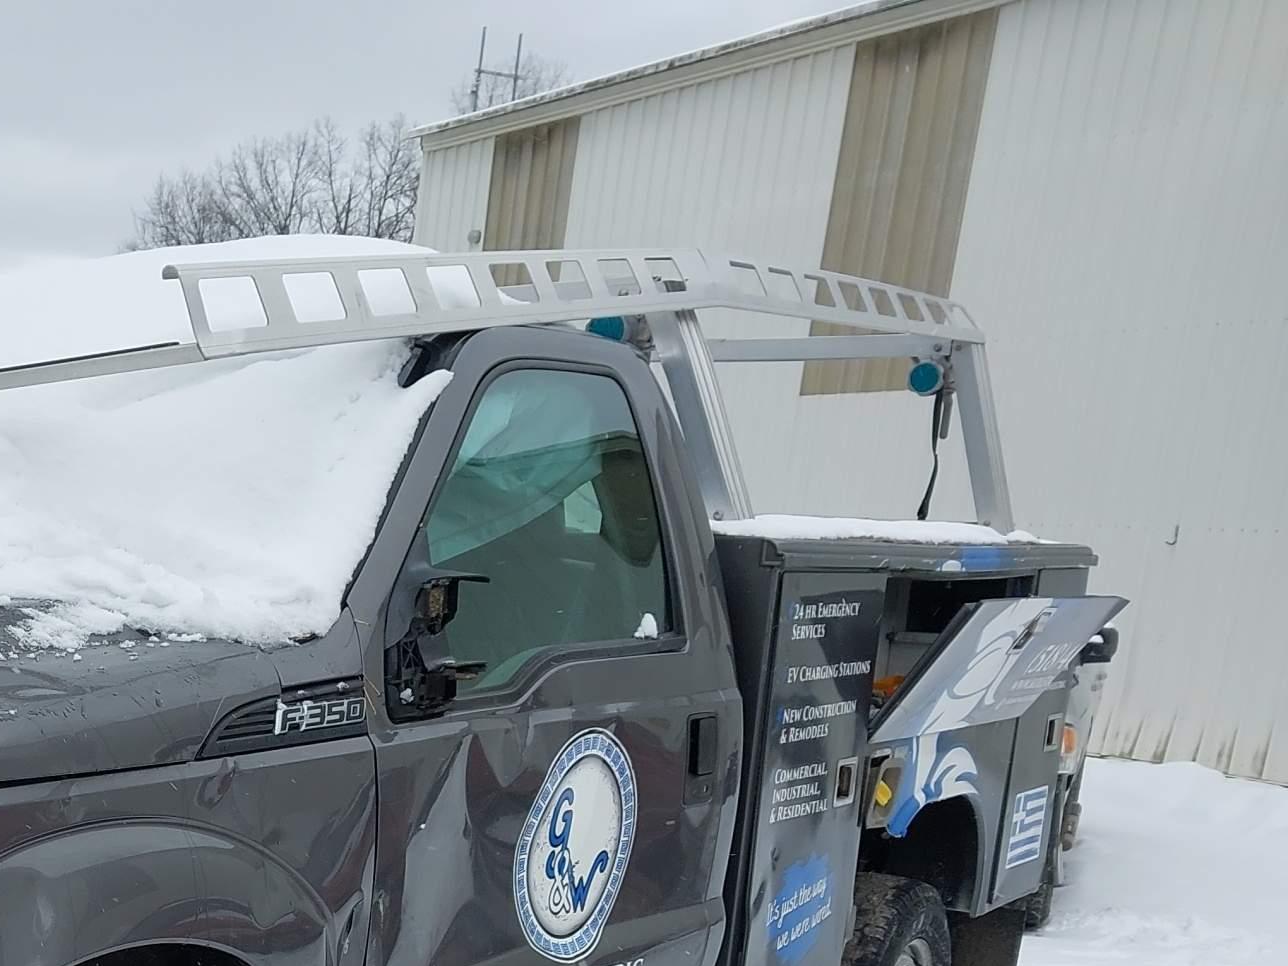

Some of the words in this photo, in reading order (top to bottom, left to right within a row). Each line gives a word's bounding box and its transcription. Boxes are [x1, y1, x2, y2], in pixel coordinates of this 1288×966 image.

[793, 603, 804, 620] 24
[805, 604, 817, 619] HR
[792, 623, 826, 641] SERVICES
[787, 666, 800, 684] EV
[800, 663, 839, 682] CHARGING
[839, 660, 872, 677] STATIONS
[782, 707, 803, 725] NEW
[803, 700, 857, 721] CONSTRUCTION
[779, 728, 787, 744] &
[789, 723, 830, 743] REMODELS
[774, 762, 828, 784] COMMERCIAL,
[769, 807, 776, 824] &
[776, 798, 828, 822] RESIDENTIAL
[766, 899, 780, 927] It's
[777, 891, 799, 929] just
[799, 883, 812, 906] the
[776, 930, 790, 951] we
[790, 917, 811, 942] were
